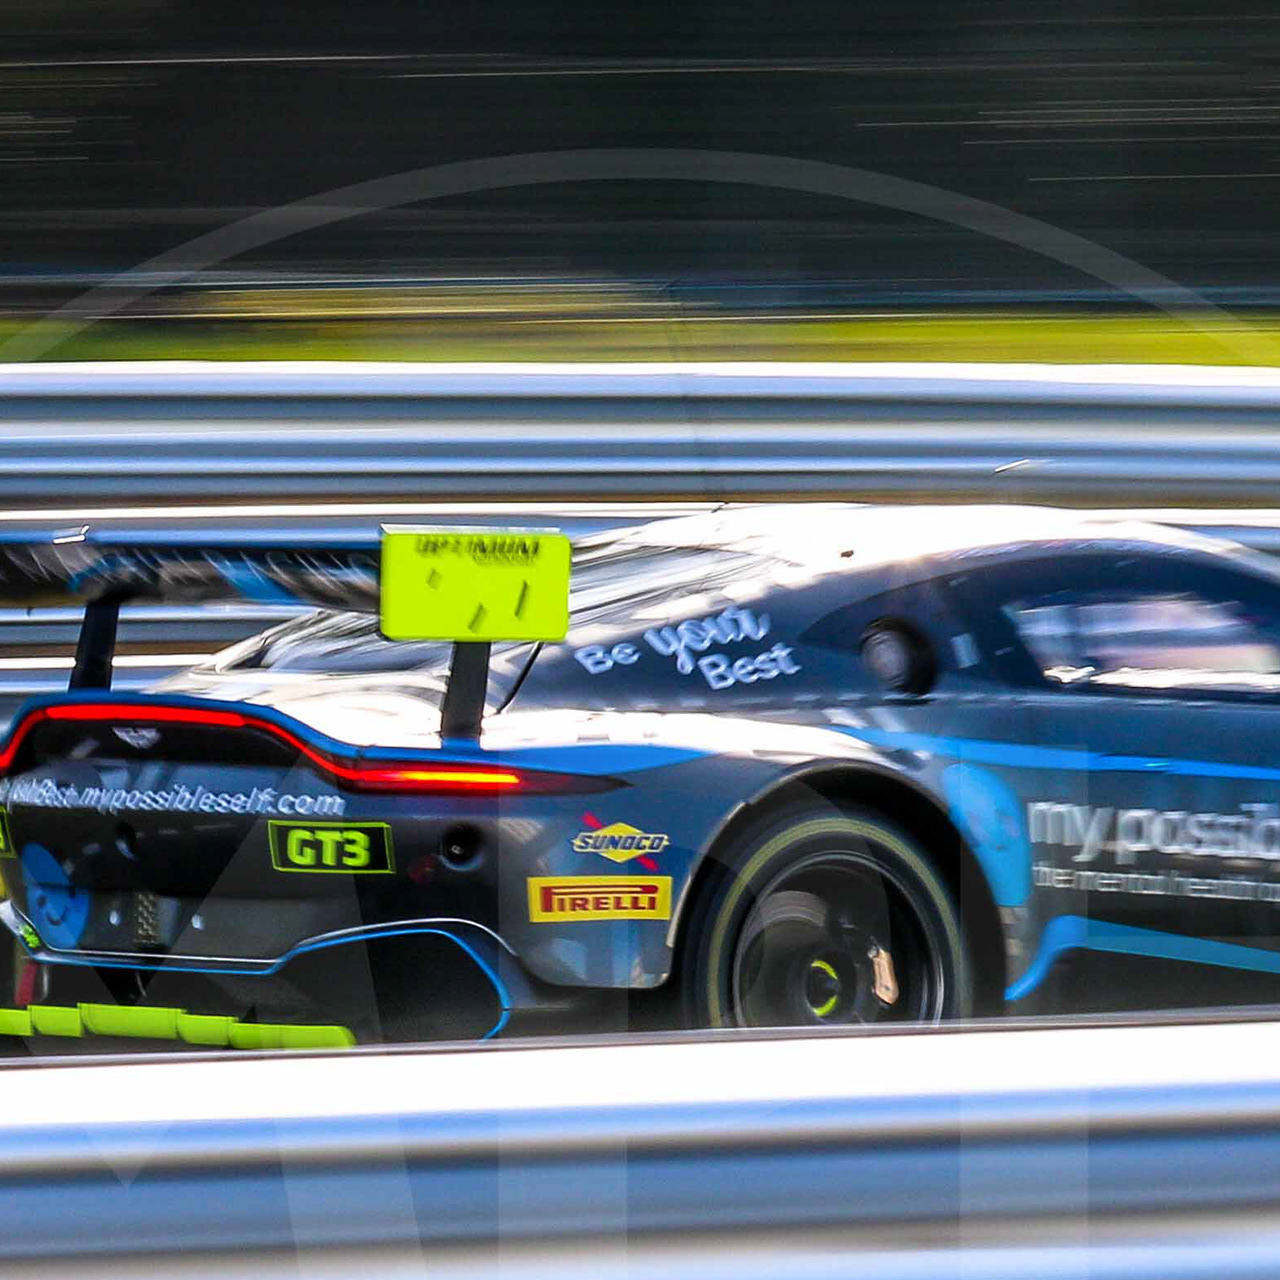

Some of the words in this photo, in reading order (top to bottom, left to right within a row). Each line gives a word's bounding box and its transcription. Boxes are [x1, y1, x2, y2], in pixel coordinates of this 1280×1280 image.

[574, 643, 641, 675] Be
[644, 606, 770, 675] your
[697, 642, 802, 690] Best
[287, 828, 372, 867] GT3
[577, 833, 665, 851] SUNOCO
[540, 885, 659, 913] PIRELLI
